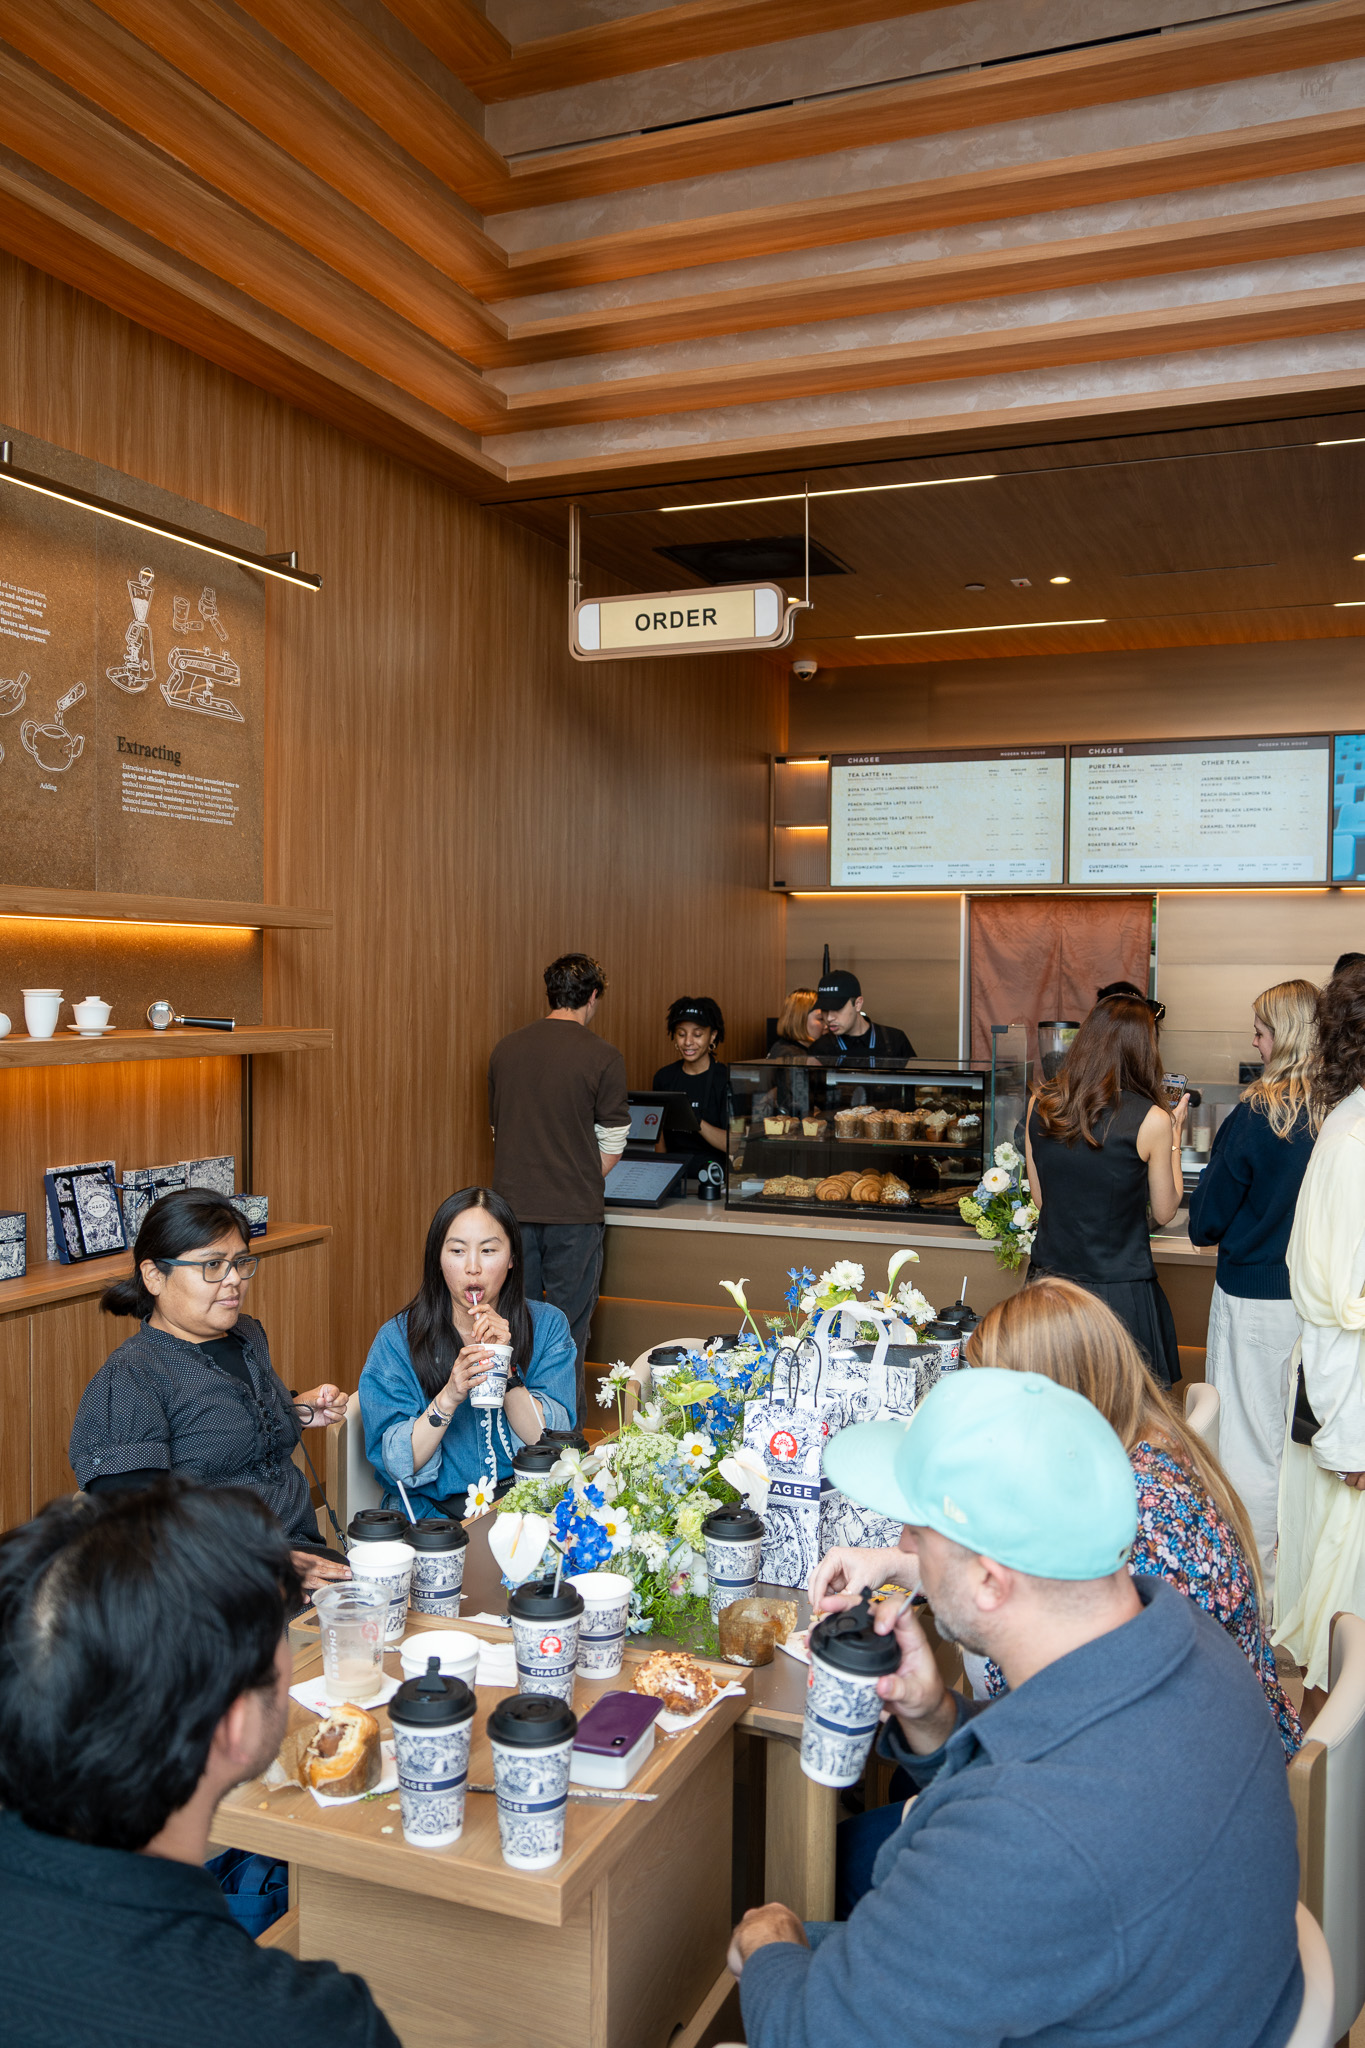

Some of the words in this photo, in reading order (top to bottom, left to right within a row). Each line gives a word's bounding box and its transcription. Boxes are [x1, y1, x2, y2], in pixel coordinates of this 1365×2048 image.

[16, 595, 34, 605] steeped
[23, 606, 43, 618] steeping
[1, 617, 18, 627] flavors
[635, 608, 718, 631] ORDER
[20, 633, 47, 644] experience.
[117, 736, 181, 767] Extracting
[122, 763, 143, 772] Extraction
[147, 776, 166, 785] efficiently
[40, 783, 57, 792] Adding
[178, 790, 204, 799] contemporary
[163, 796, 185, 804] consistency
[768, 1482, 812, 1498] AGEE
[329, 1629, 339, 1679] CHAGEE
[530, 1666, 569, 1676] CHAGEE
